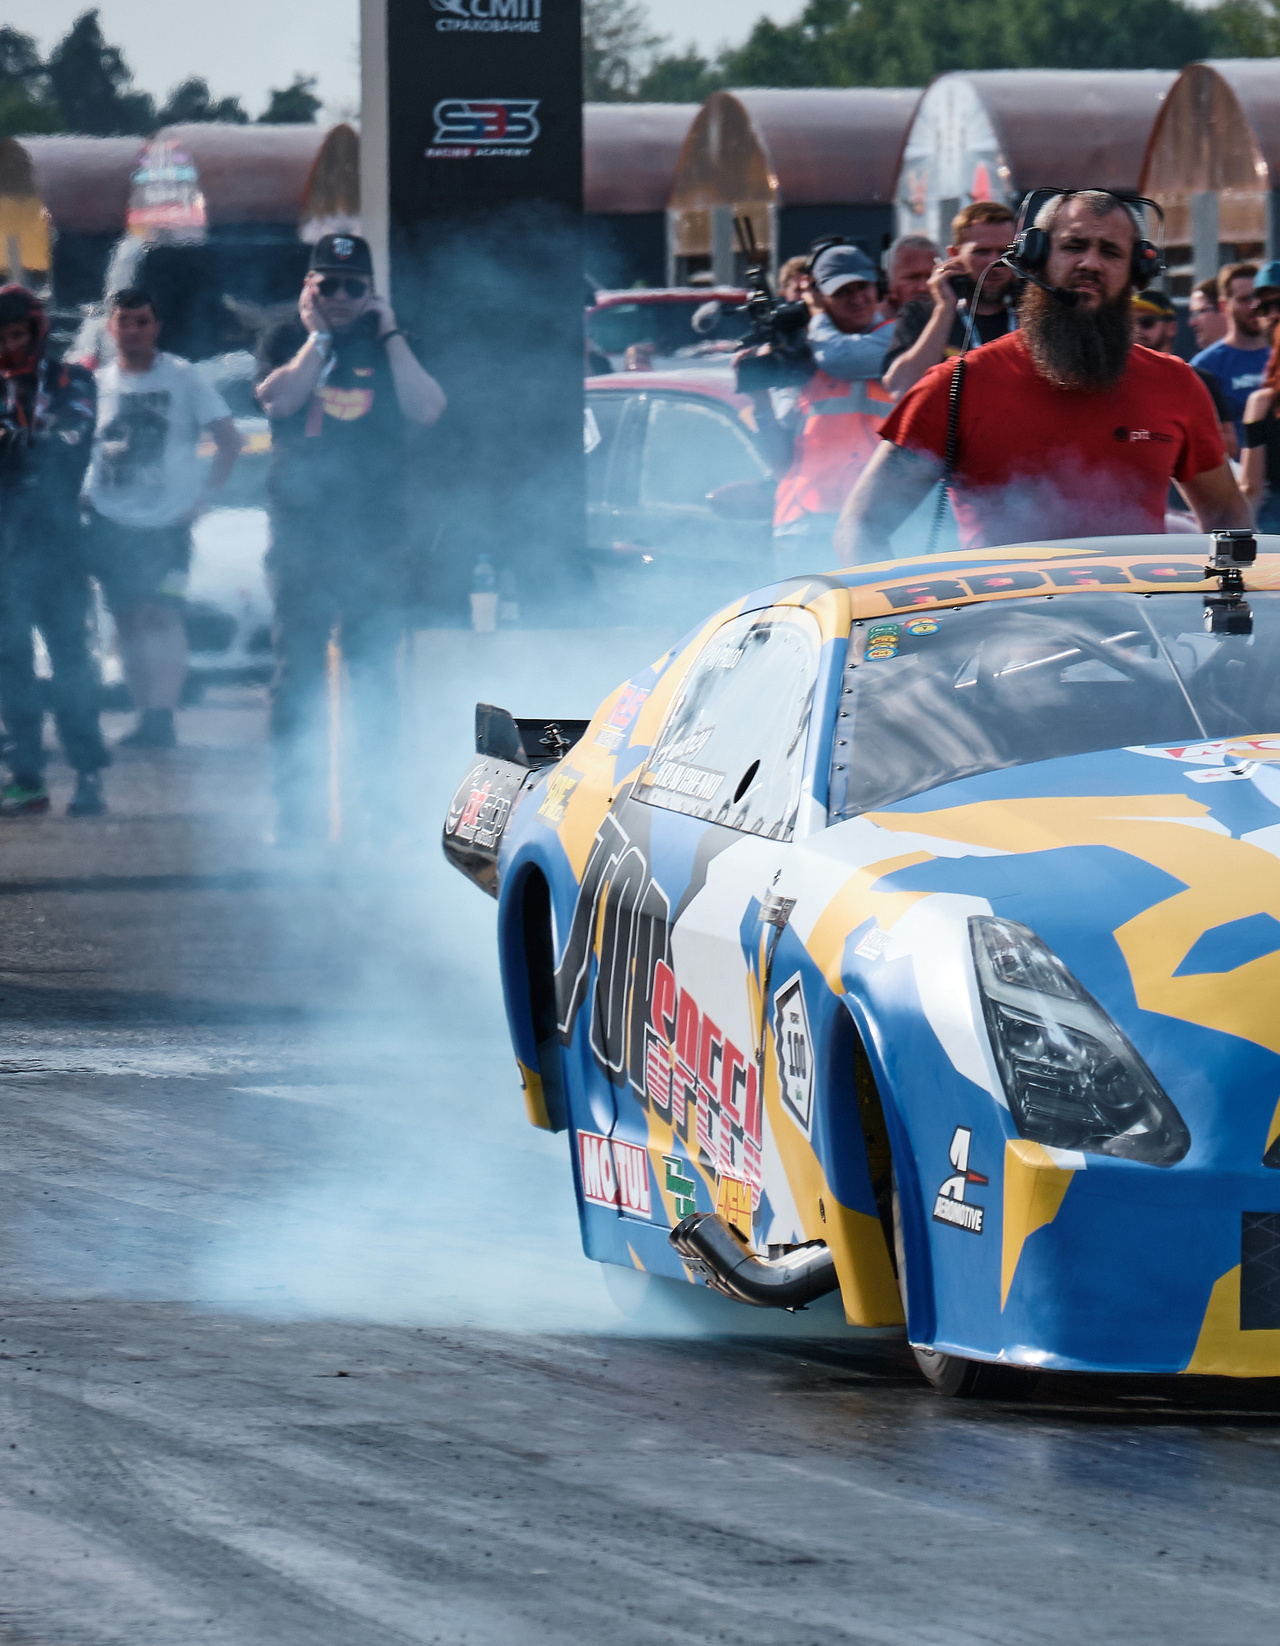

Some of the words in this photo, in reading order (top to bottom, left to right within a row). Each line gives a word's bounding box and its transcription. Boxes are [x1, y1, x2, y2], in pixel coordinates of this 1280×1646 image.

[435, 18, 541, 33] СТРАХОВАНИЕ
[581, 1135, 650, 1213] MOTUL
[932, 1195, 984, 1233] AEROMOTIVE
